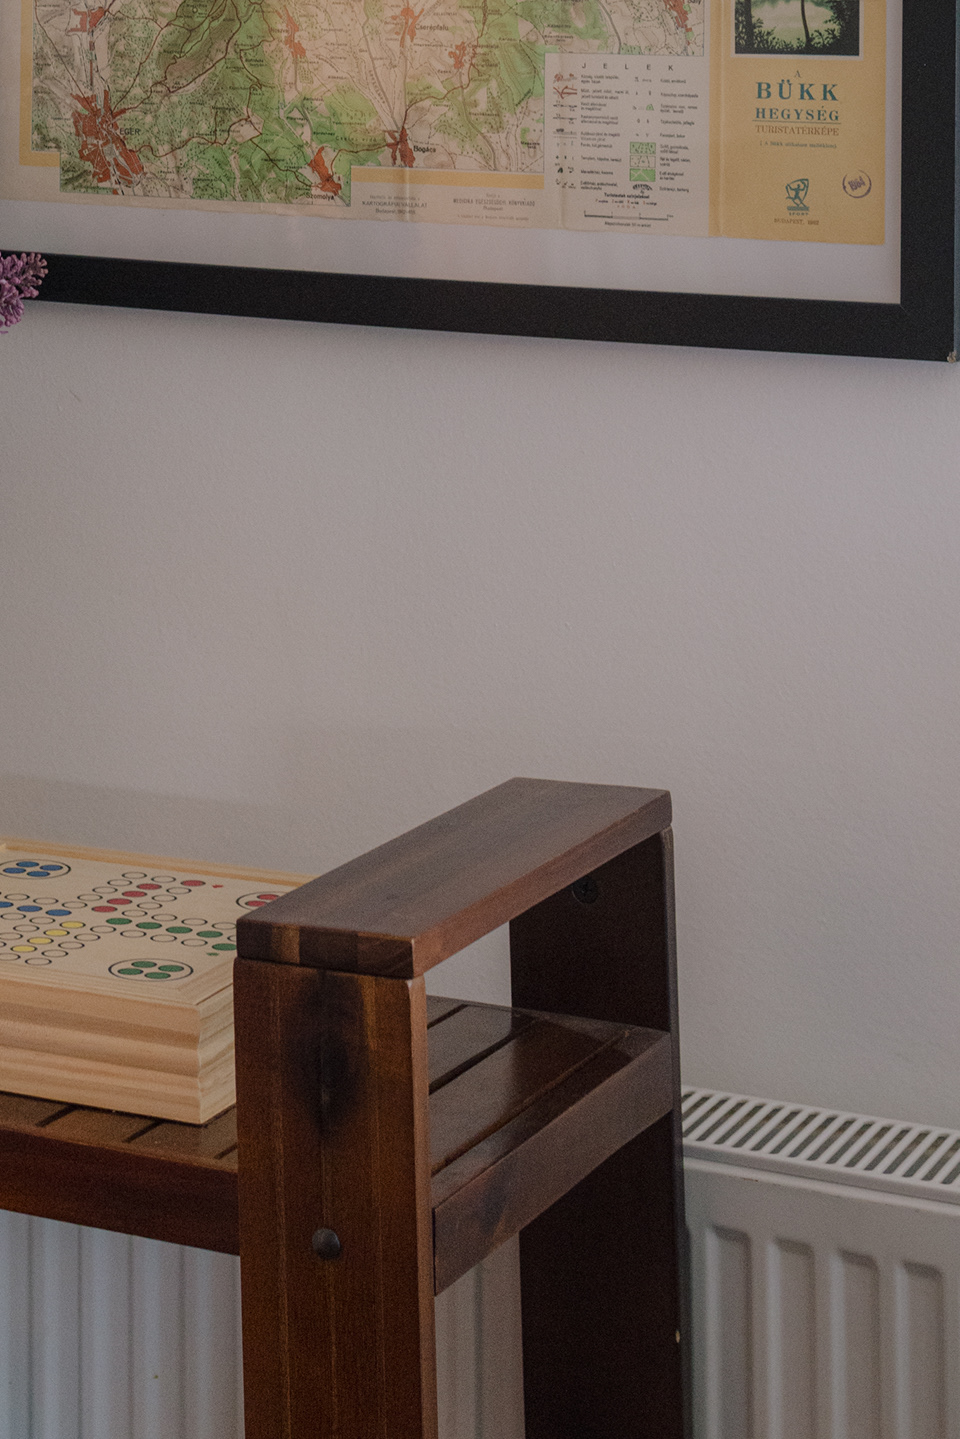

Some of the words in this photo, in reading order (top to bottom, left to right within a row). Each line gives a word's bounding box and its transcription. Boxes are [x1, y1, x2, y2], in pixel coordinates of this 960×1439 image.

[756, 79, 839, 101] BÜKK
[755, 105, 840, 122] HEGYSÉG
[120, 128, 141, 137] EGER
[755, 124, 840, 136] TURISTATÉRKÉPE
[413, 145, 437, 154] Bogács
